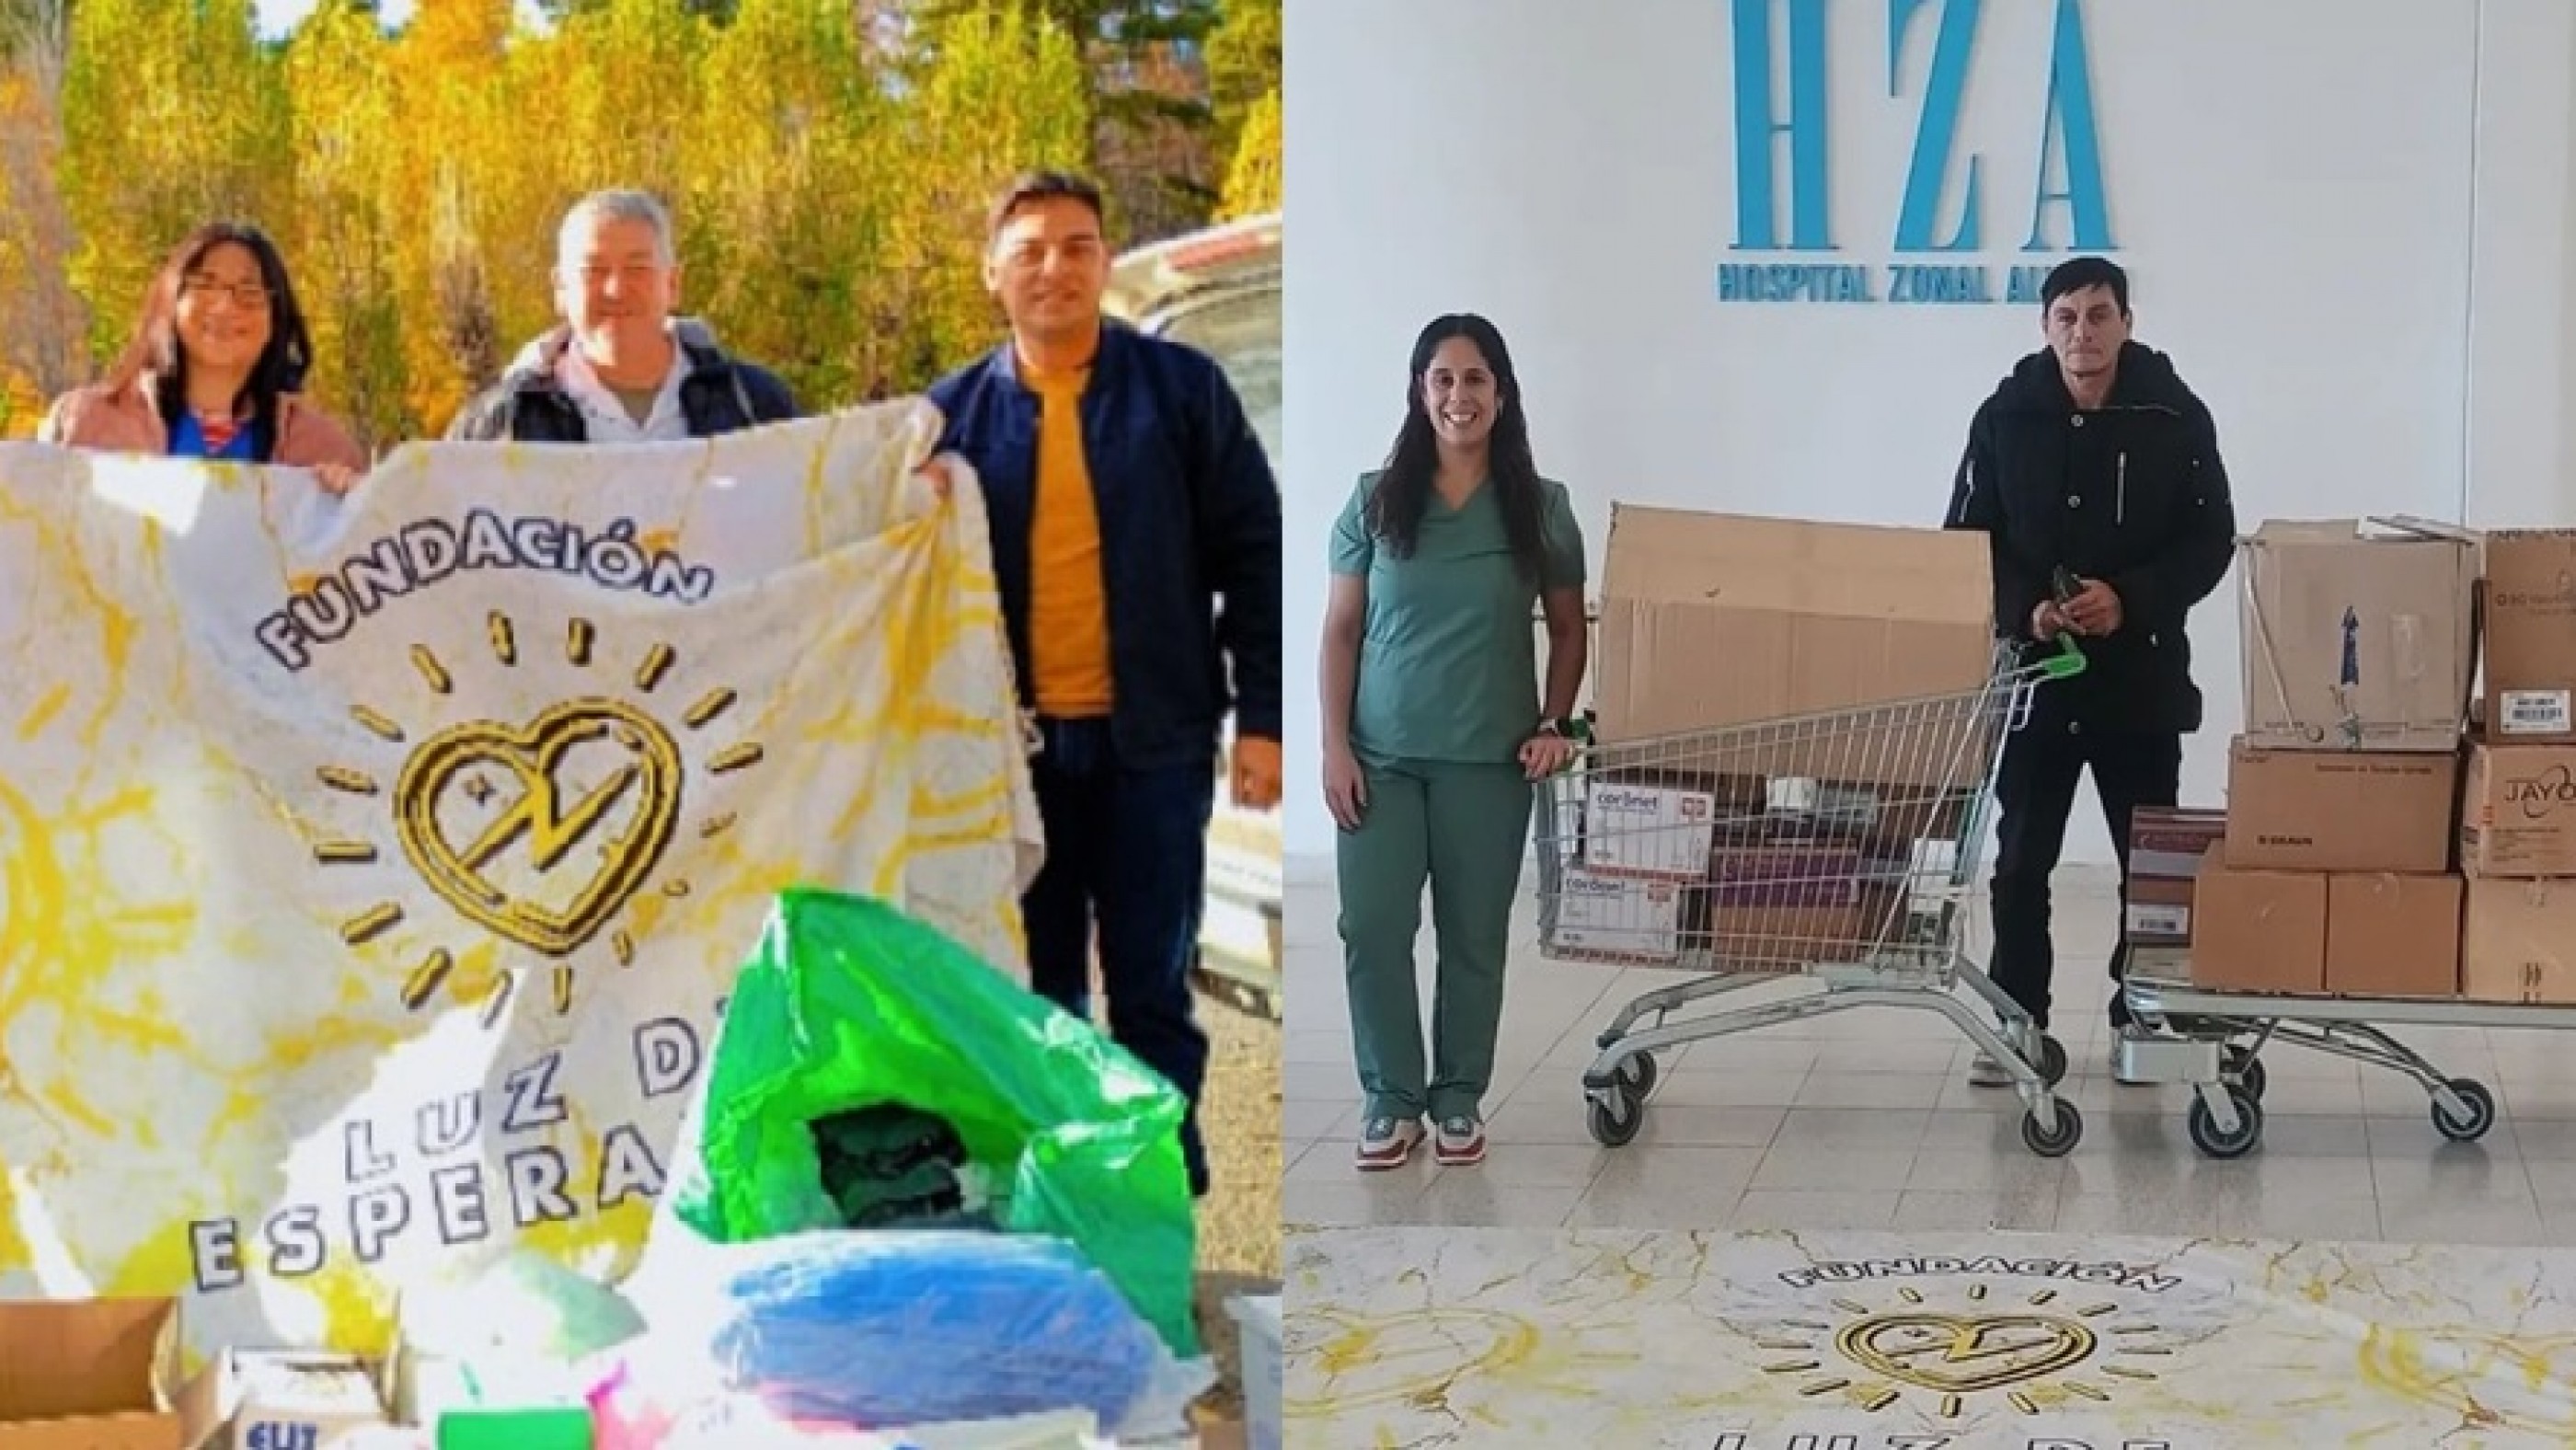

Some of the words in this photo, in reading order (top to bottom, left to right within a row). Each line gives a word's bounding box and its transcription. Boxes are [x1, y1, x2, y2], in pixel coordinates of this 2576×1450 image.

[1729, 0, 2120, 251] HZA
[1718, 263, 1877, 303] HOSPITAL
[1886, 264, 1995, 304] ZONAL
[255, 507, 715, 672] FUNDACIÓN
[345, 1052, 569, 1184] LUZ
[188, 1122, 668, 1292] ESPERA
